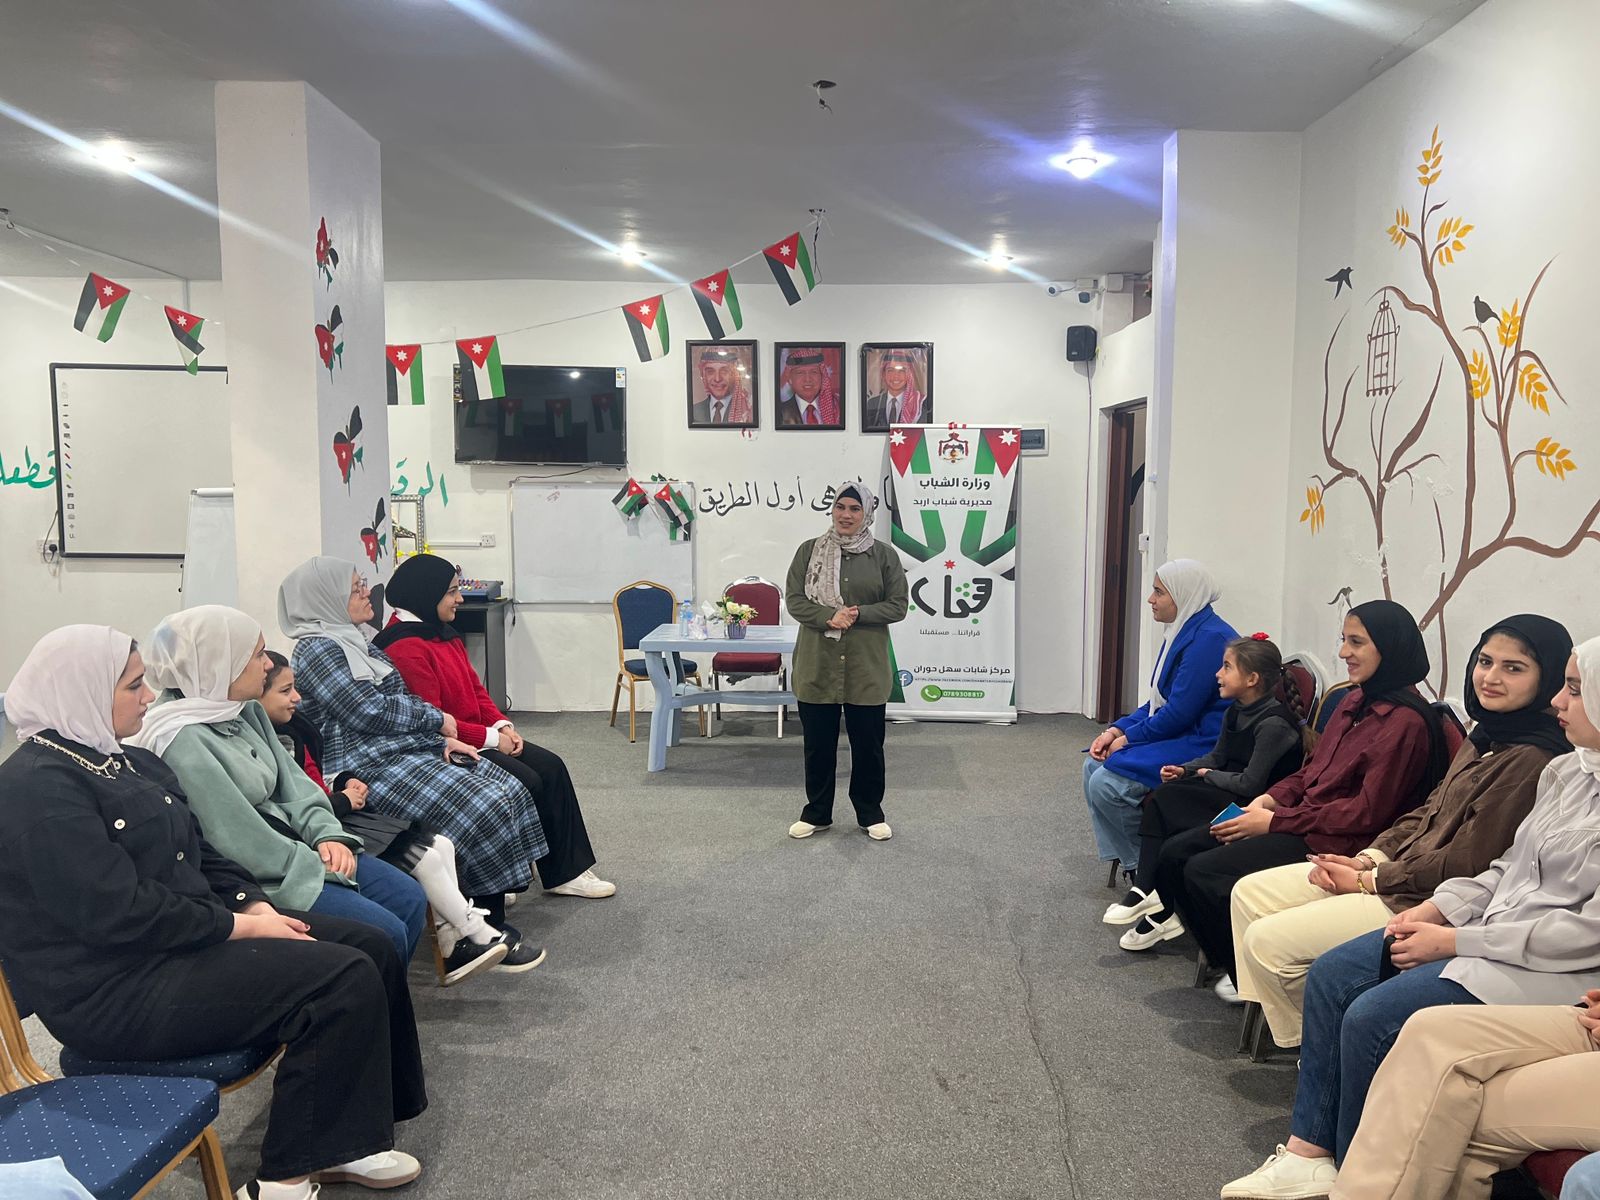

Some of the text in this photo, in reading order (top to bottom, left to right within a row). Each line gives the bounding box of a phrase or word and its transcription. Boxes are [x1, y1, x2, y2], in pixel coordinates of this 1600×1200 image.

[0, 445, 56, 489] قطع
[391, 457, 449, 507] الوق
[919, 476, 991, 490] وزارة الشباب
[699, 480, 760, 517] الطريق
[766, 475, 804, 511] أول
[913, 497, 992, 508] مديرية شباب اربد
[913, 665, 1011, 676] مركز شابات سهل حوران
